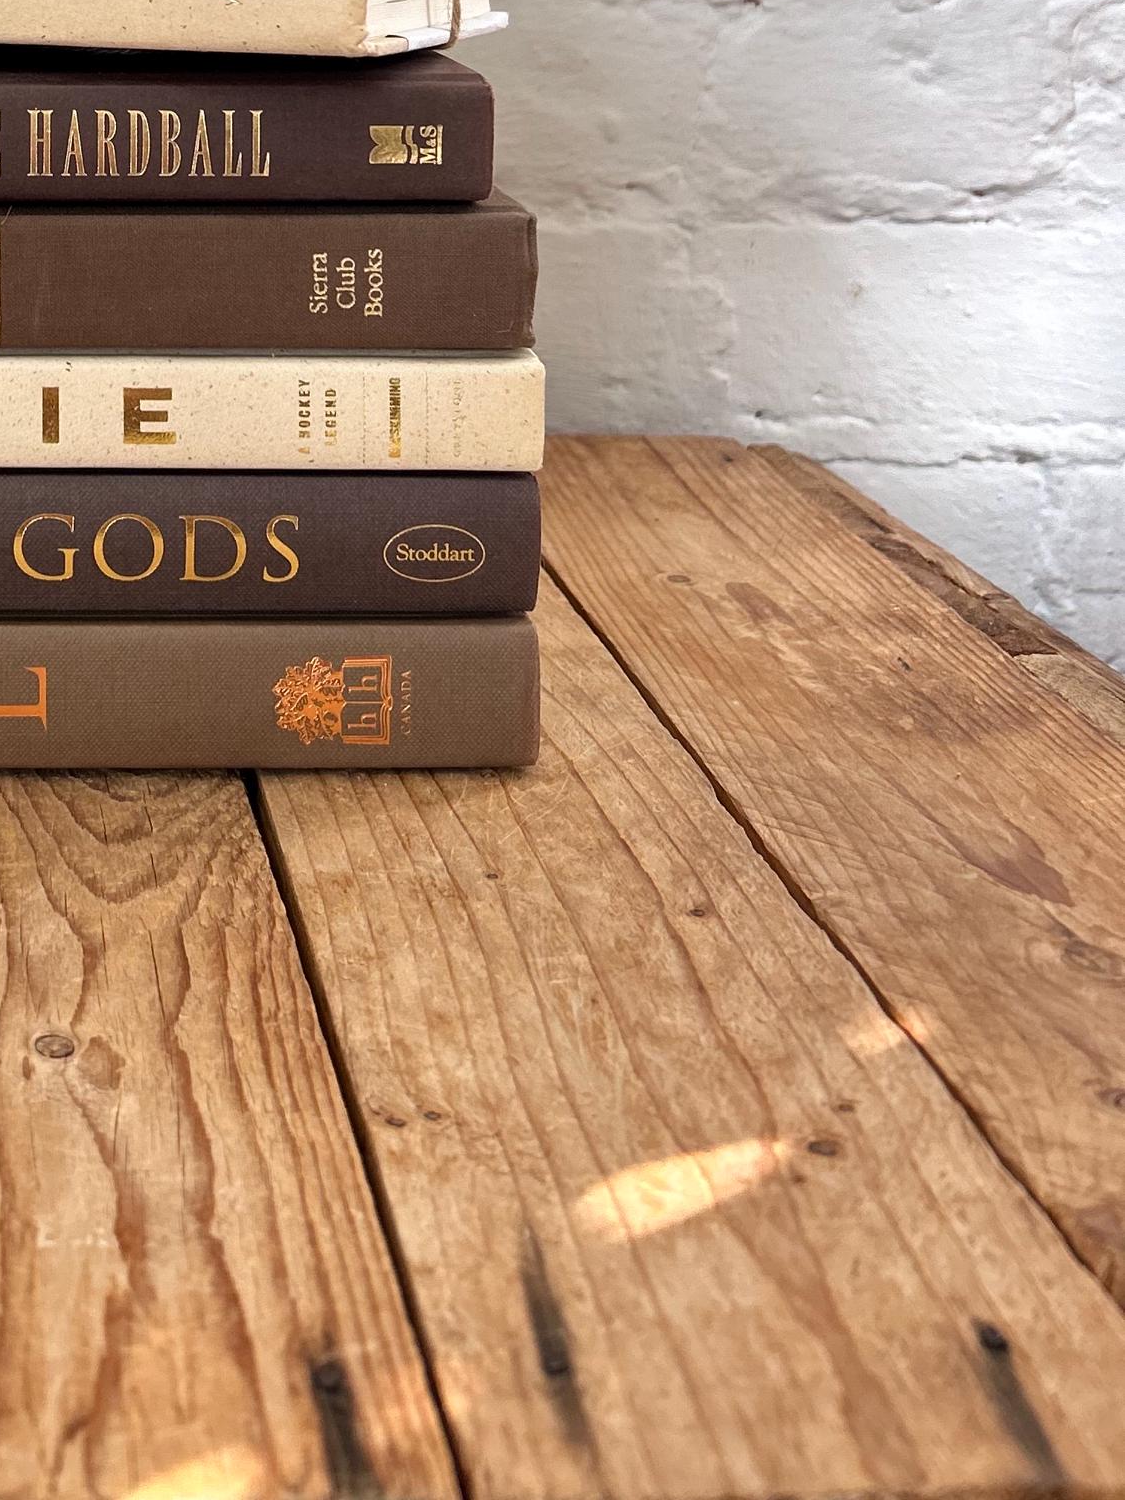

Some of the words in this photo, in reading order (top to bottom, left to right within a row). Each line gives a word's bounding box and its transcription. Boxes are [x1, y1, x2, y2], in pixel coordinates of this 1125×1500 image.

[26, 109, 270, 177] HARDBALL
[419, 125, 437, 165] M&S
[309, 252, 329, 314] Sierra
[336, 256, 356, 310] Club
[364, 247, 384, 318] Books
[12, 513, 300, 582] GODS
[395, 543, 475, 564] Stoddart
[401, 669, 412, 735] CANADA
